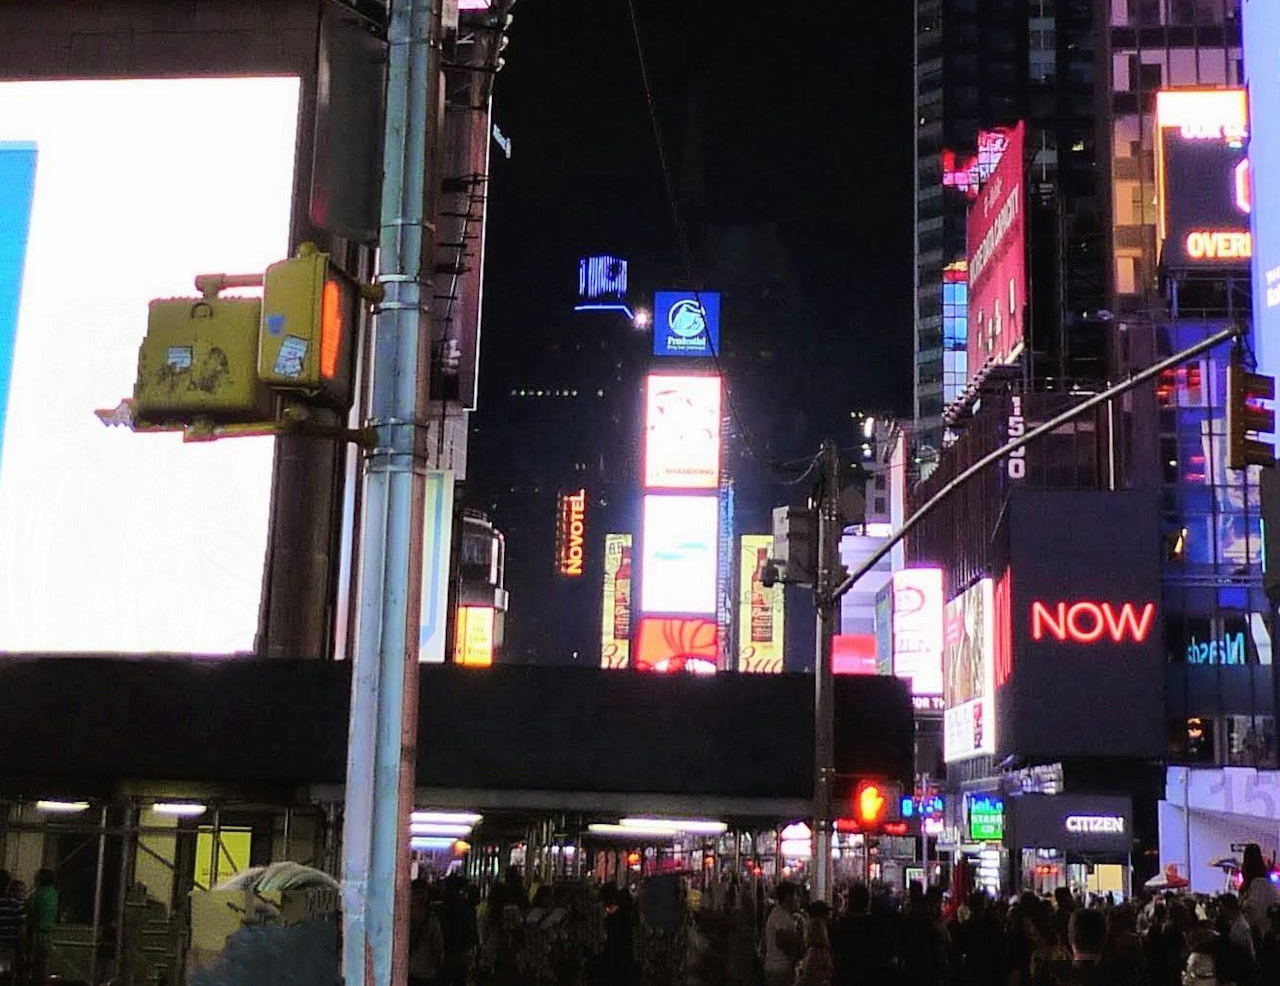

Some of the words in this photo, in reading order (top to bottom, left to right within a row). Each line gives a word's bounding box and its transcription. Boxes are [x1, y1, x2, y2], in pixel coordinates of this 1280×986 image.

[567, 488, 585, 574] NOVOTEL
[1032, 601, 1155, 643] NOW
[1065, 816, 1124, 833] CITIZEN
